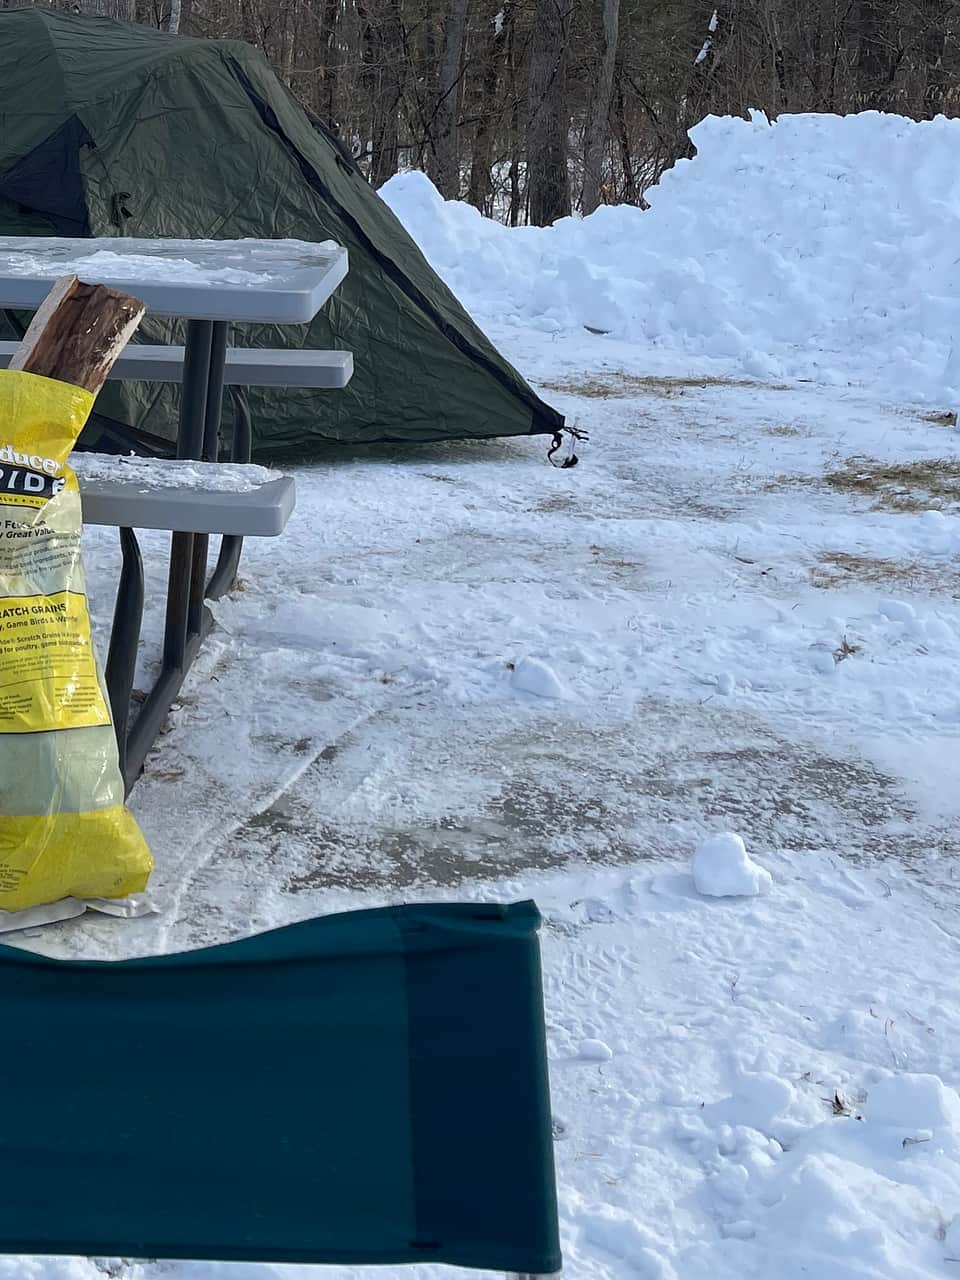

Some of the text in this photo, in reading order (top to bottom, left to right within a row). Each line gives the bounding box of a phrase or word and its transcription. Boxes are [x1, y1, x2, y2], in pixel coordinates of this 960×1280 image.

[6, 529, 33, 539] Great
[31, 603, 67, 615] GRAINS
[6, 620, 28, 629] Game
[4, 646, 14, 654] for
